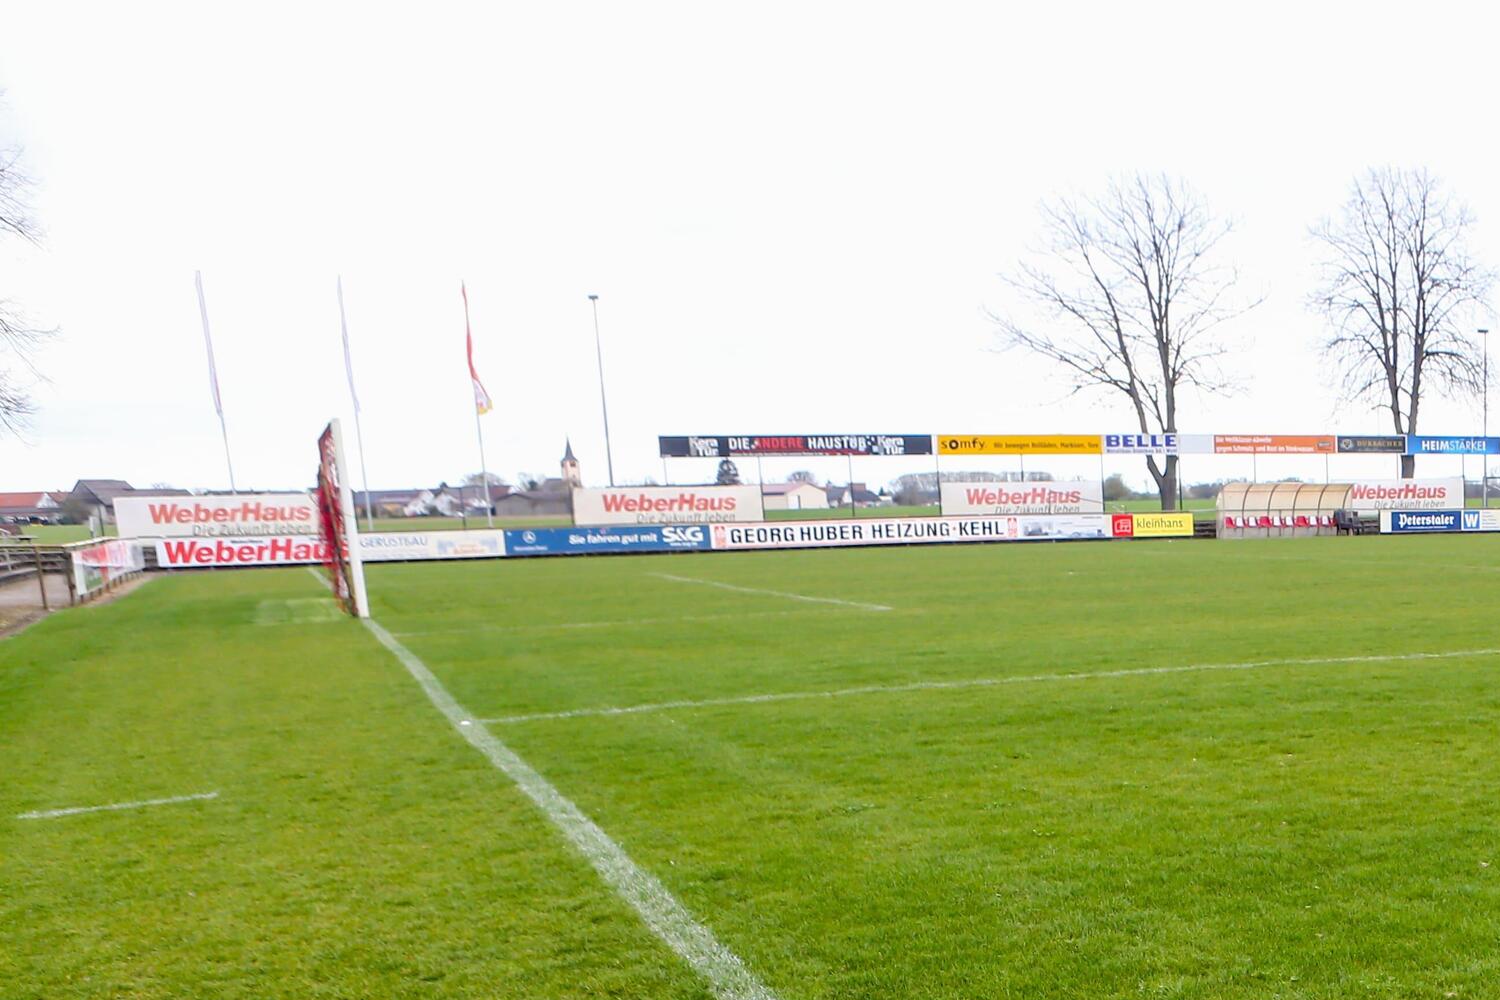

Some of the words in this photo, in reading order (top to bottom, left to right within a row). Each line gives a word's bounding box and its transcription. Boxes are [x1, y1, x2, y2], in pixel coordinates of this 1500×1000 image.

[729, 438, 750, 450] DIE
[756, 438, 804, 449] ANDERE
[941, 437, 985, 450] somfy
[1106, 435, 1177, 447] BELLE
[966, 488, 1081, 505] WeberHaus
[1351, 484, 1446, 500] WeberHaus
[602, 493, 737, 513] WeberHaus
[995, 506, 1010, 514] Die
[1053, 504, 1080, 513] leben
[148, 502, 311, 524] WeberHaus
[637, 514, 656, 524] Die
[658, 512, 702, 524] Zukunft
[704, 511, 737, 522] leben
[1464, 513, 1479, 528] W
[1136, 514, 1184, 528] kleinhans
[192, 525, 216, 537] Die
[661, 527, 704, 543] S&G
[731, 528, 795, 544] GEORG
[800, 525, 863, 541] HUBER
[872, 522, 950, 539] HEIZUNG
[959, 520, 1005, 536] KEHL
[568, 535, 587, 545] Sie
[588, 533, 621, 545] fahren
[622, 533, 640, 547] gut
[641, 531, 657, 543] mit
